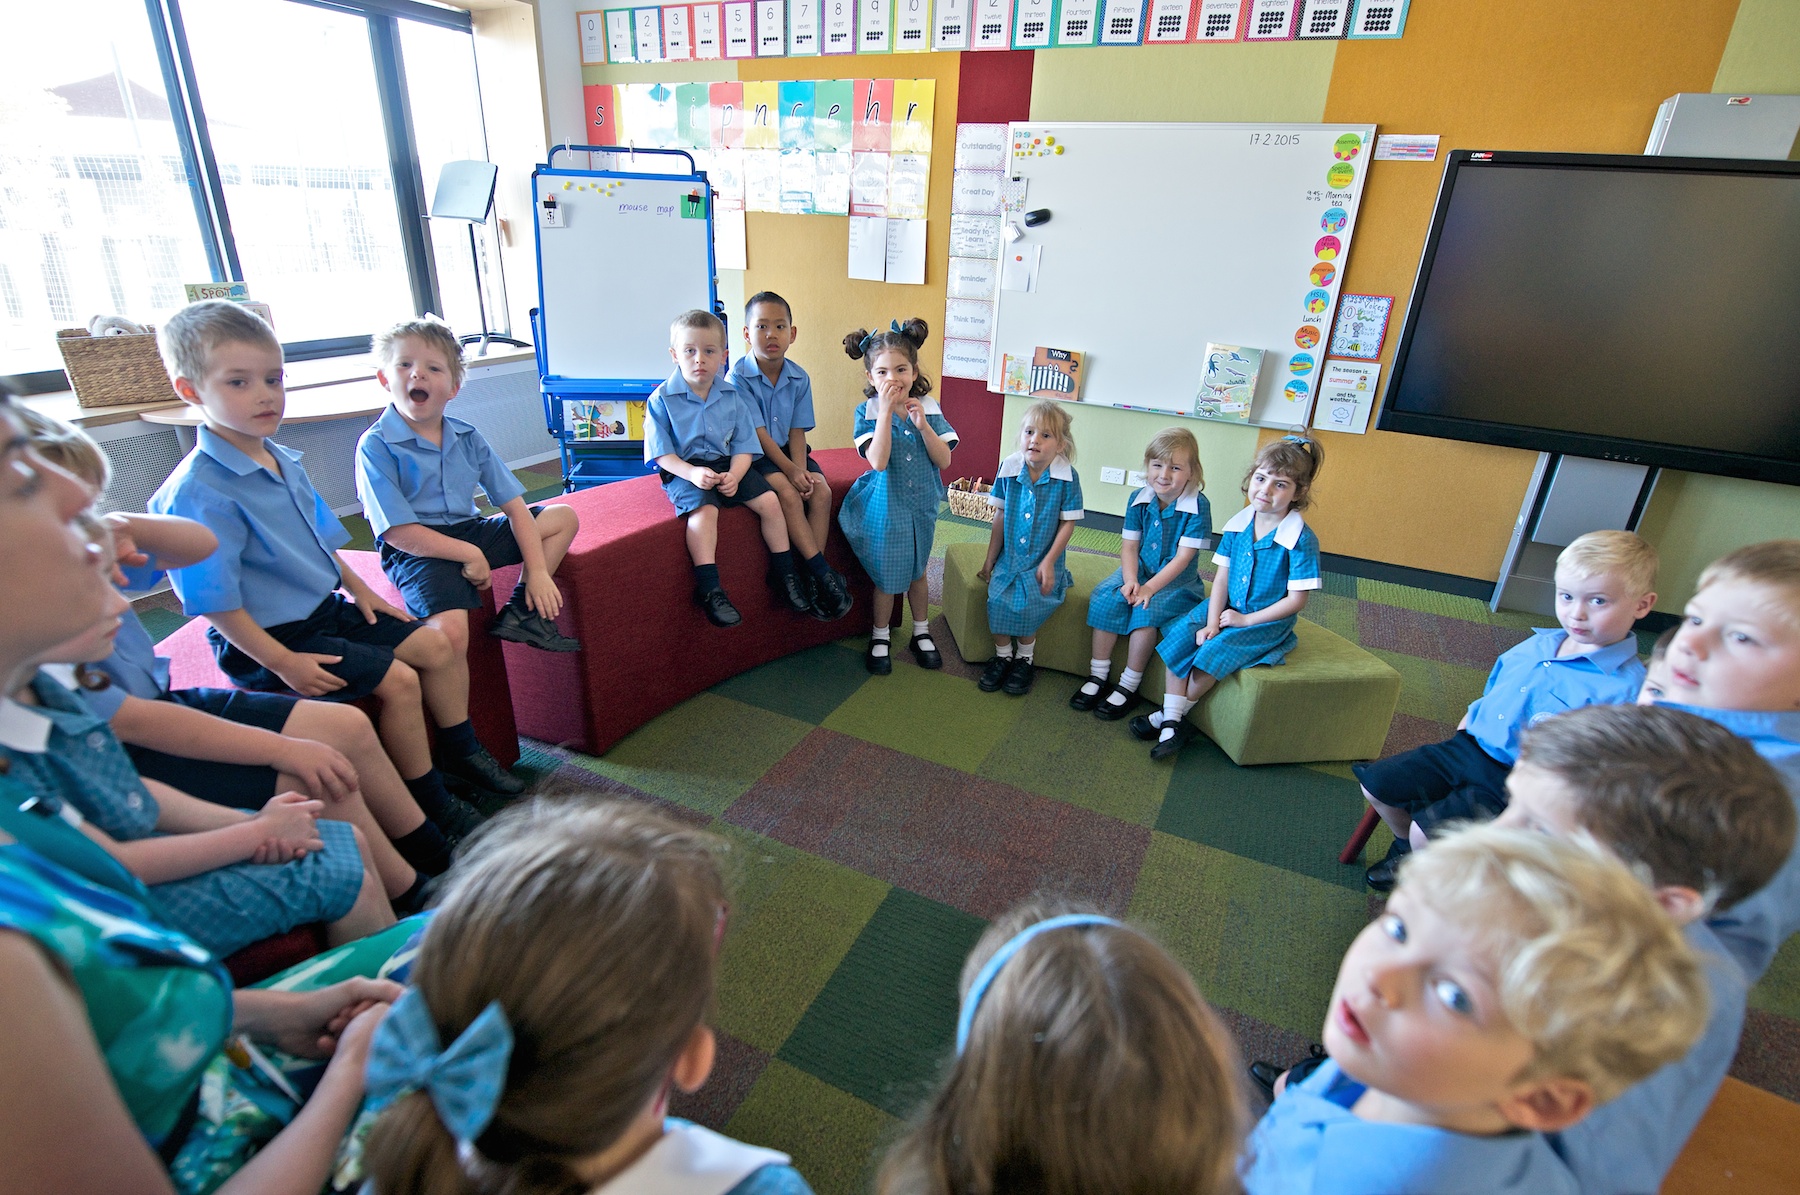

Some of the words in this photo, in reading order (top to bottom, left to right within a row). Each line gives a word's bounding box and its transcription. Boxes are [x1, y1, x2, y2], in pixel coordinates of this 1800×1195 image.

[834, 2, 842, 16] 8
[871, 0, 879, 13] 9
[908, 0, 919, 12] 10
[1113, 6, 1136, 14] fifteen
[1205, 2, 1238, 10] seventeen
[1261, 0, 1289, 8] eighteen
[703, 11, 710, 23] 4
[734, 9, 742, 22] 5
[766, 7, 774, 20] 6
[801, 4, 808, 18] 7
[587, 19, 595, 31] 0
[644, 15, 650, 28] 2
[672, 13, 680, 26] 3
[833, 21, 845, 29] eight
[865, 81, 881, 126] h
[594, 105, 604, 126] s
[754, 104, 767, 126] n
[906, 102, 917, 125] r
[720, 104, 733, 145] p
[961, 142, 1002, 152] Outstanding
[961, 187, 980, 195] Great
[981, 188, 996, 197] Day
[1325, 191, 1352, 202] Morning
[618, 203, 649, 212] mouse
[656, 205, 675, 218] map
[961, 227, 981, 236] Ready
[959, 275, 987, 283] eminder
[953, 315, 969, 323] Think
[970, 316, 985, 325] Time
[1302, 315, 1322, 323] Lunch
[1300, 327, 1318, 337] Music
[1338, 338, 1346, 349] 2
[946, 353, 987, 365] Consequence
[1050, 349, 1068, 360] Why
[1328, 377, 1355, 385] summer
